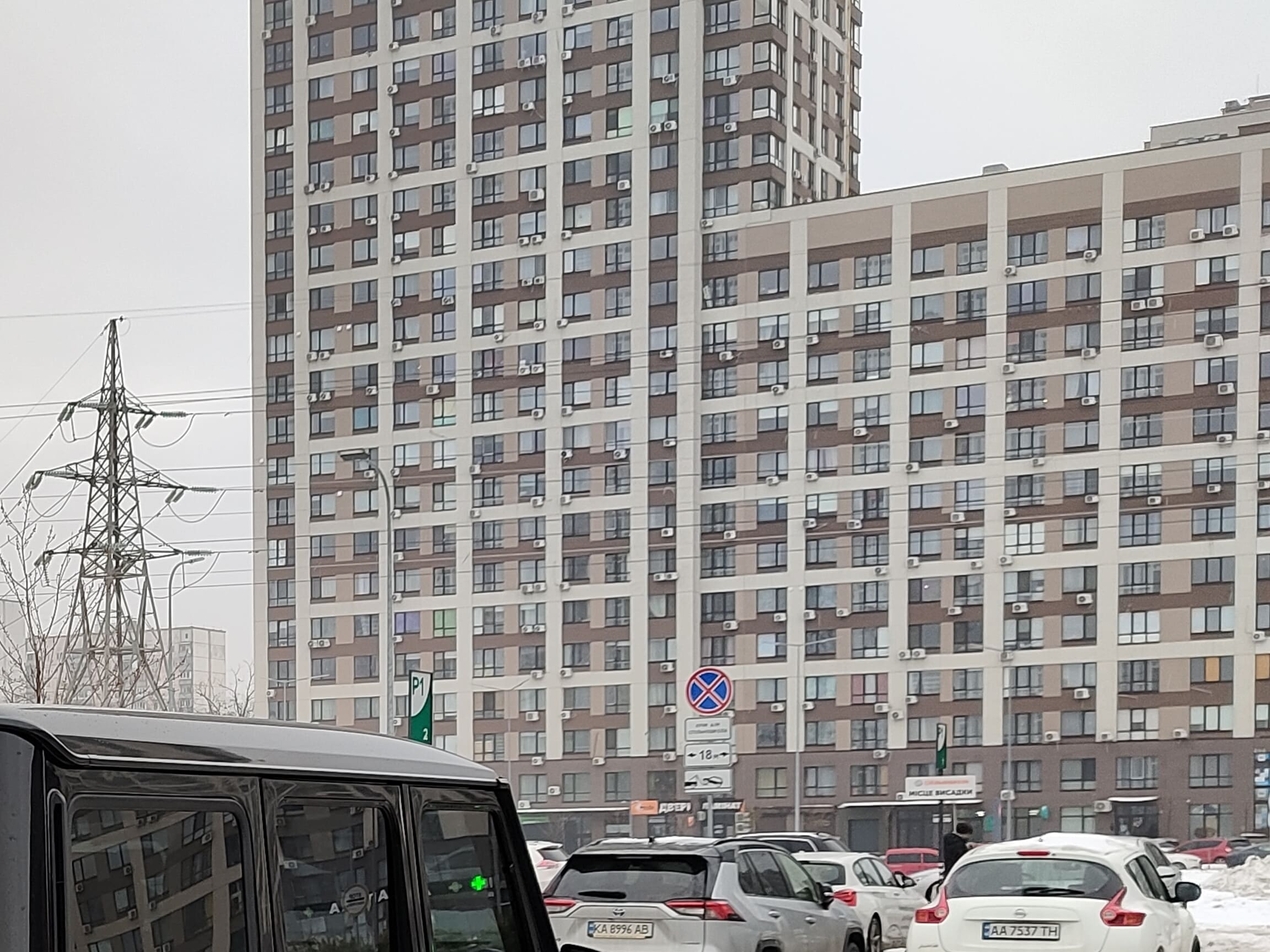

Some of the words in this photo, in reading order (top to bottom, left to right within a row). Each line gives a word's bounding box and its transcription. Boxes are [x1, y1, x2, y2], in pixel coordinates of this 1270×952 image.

[412, 676, 424, 696] P1
[422, 728, 429, 740] 2
[699, 749, 712, 760] 18
[991, 926, 1007, 936] AA
[1010, 926, 1038, 936] 7537
[1040, 926, 1058, 937] TH
